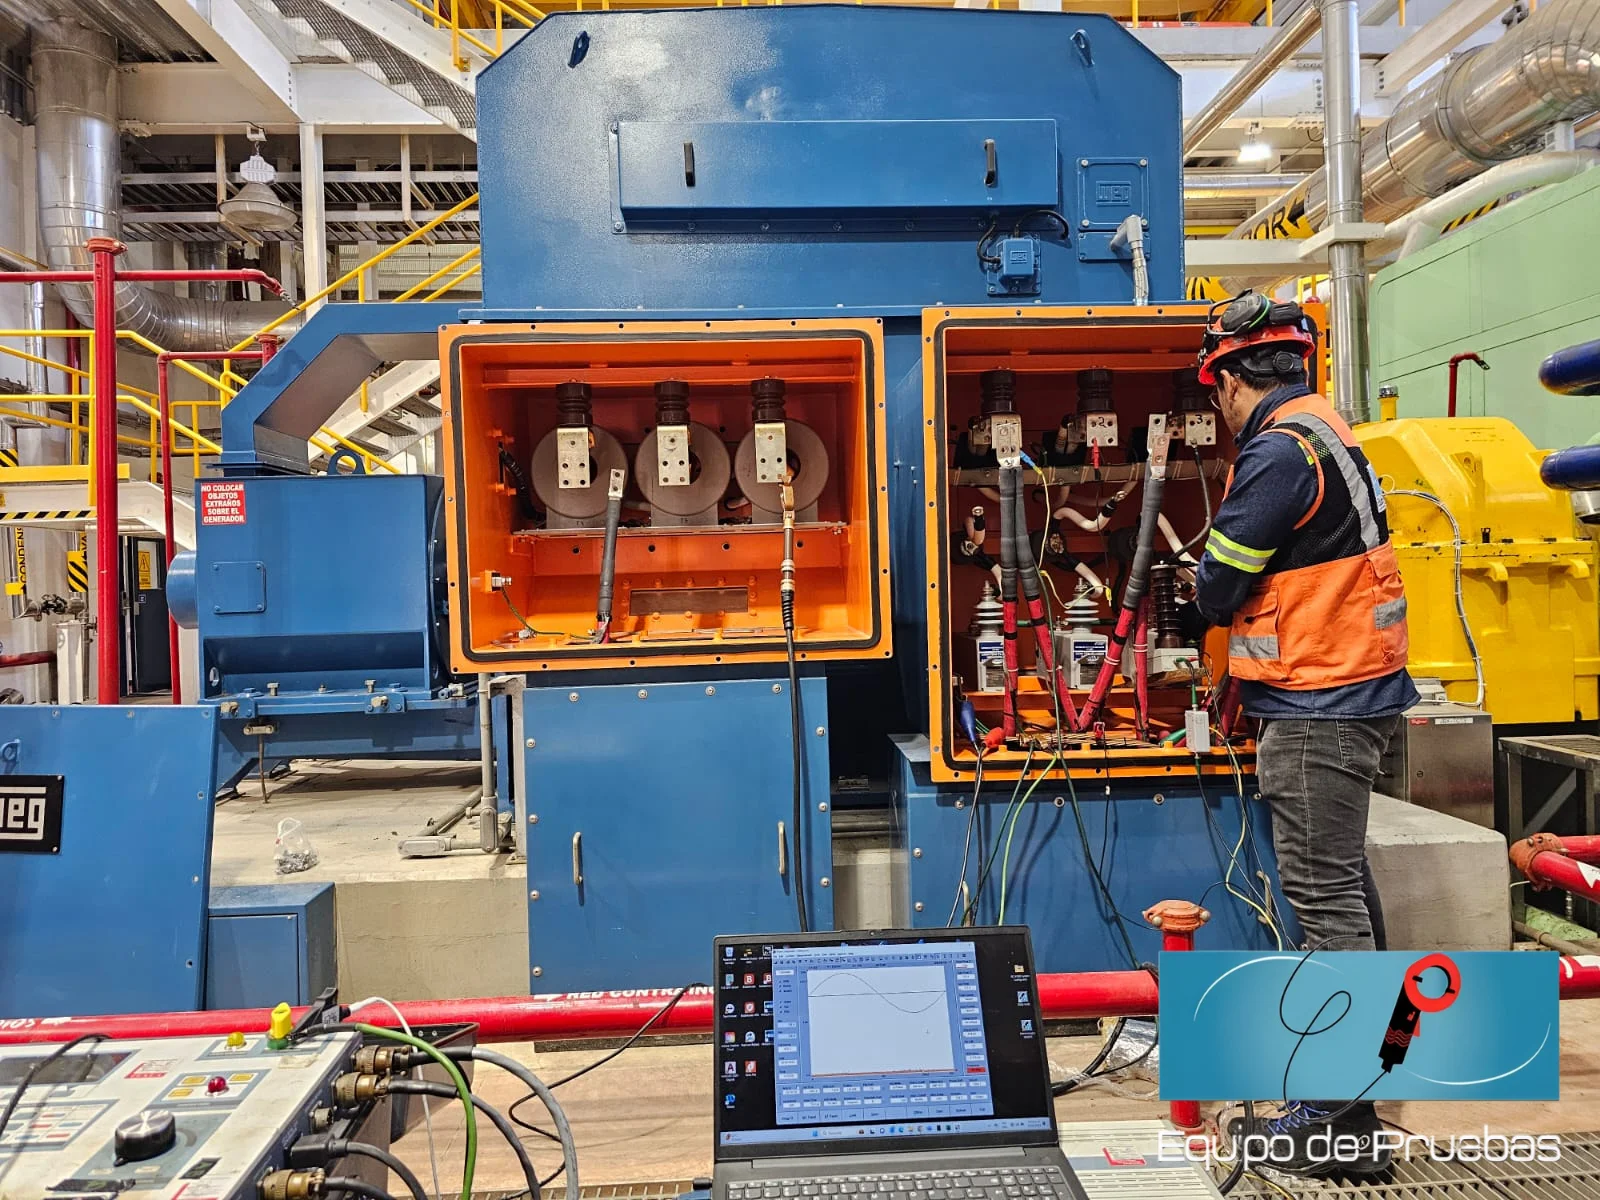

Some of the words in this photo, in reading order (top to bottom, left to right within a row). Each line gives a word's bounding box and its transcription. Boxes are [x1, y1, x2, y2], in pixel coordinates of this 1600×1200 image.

[1099, 416, 1107, 428] 2
[1196, 414, 1204, 424] 3
[212, 484, 244, 492] COLOCAR
[205, 499, 241, 508] EXTRAÑOS
[203, 515, 245, 523] GENERADOR
